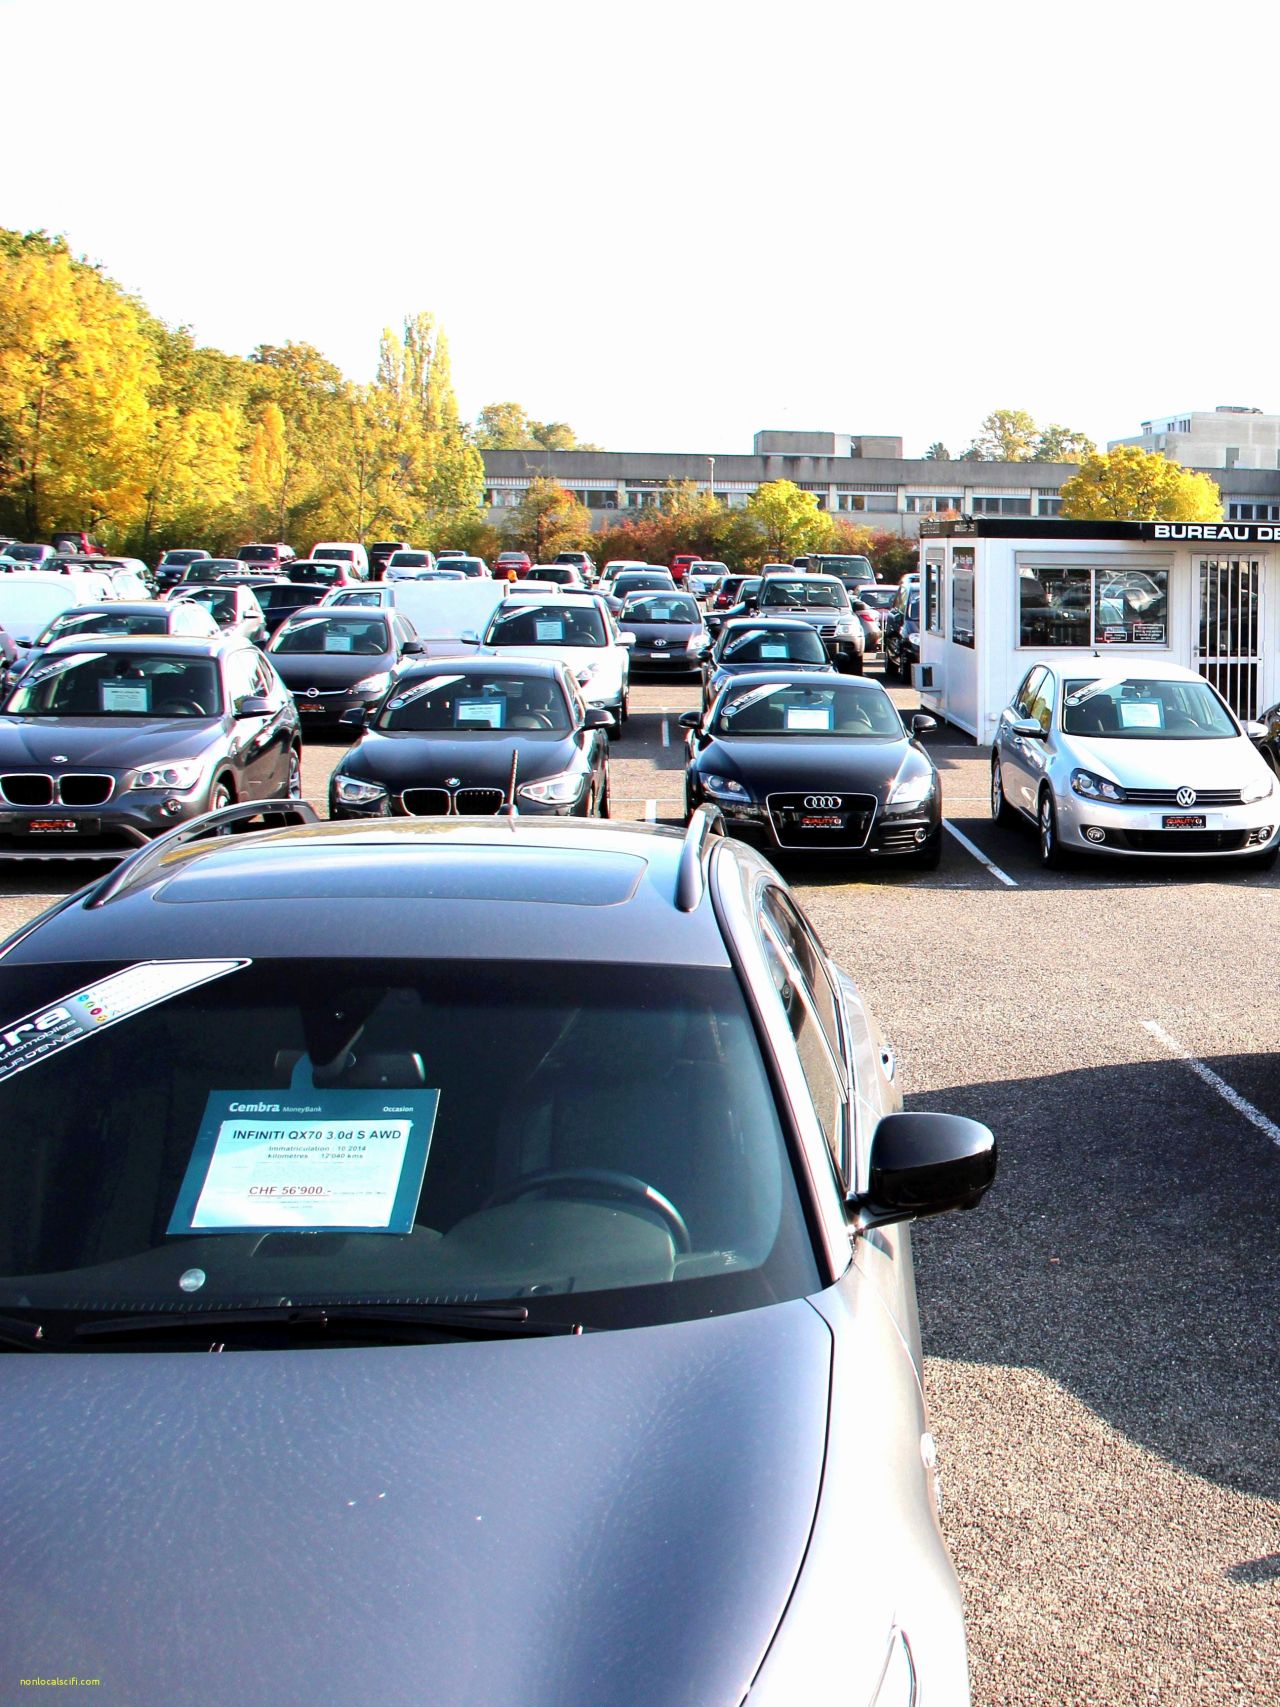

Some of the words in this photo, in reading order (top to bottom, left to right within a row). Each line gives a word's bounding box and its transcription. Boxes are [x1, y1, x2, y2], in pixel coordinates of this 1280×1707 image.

[1154, 524, 1249, 540] BUREAU
[229, 1102, 280, 1113] Cembra
[282, 1106, 322, 1114] MoneyBank
[233, 1130, 285, 1140] INFINITI
[288, 1130, 323, 1140] QX70
[326, 1130, 354, 1140] 3.0d
[357, 1130, 366, 1140] S
[369, 1130, 402, 1139] AWD
[249, 1186, 278, 1195] CHF
